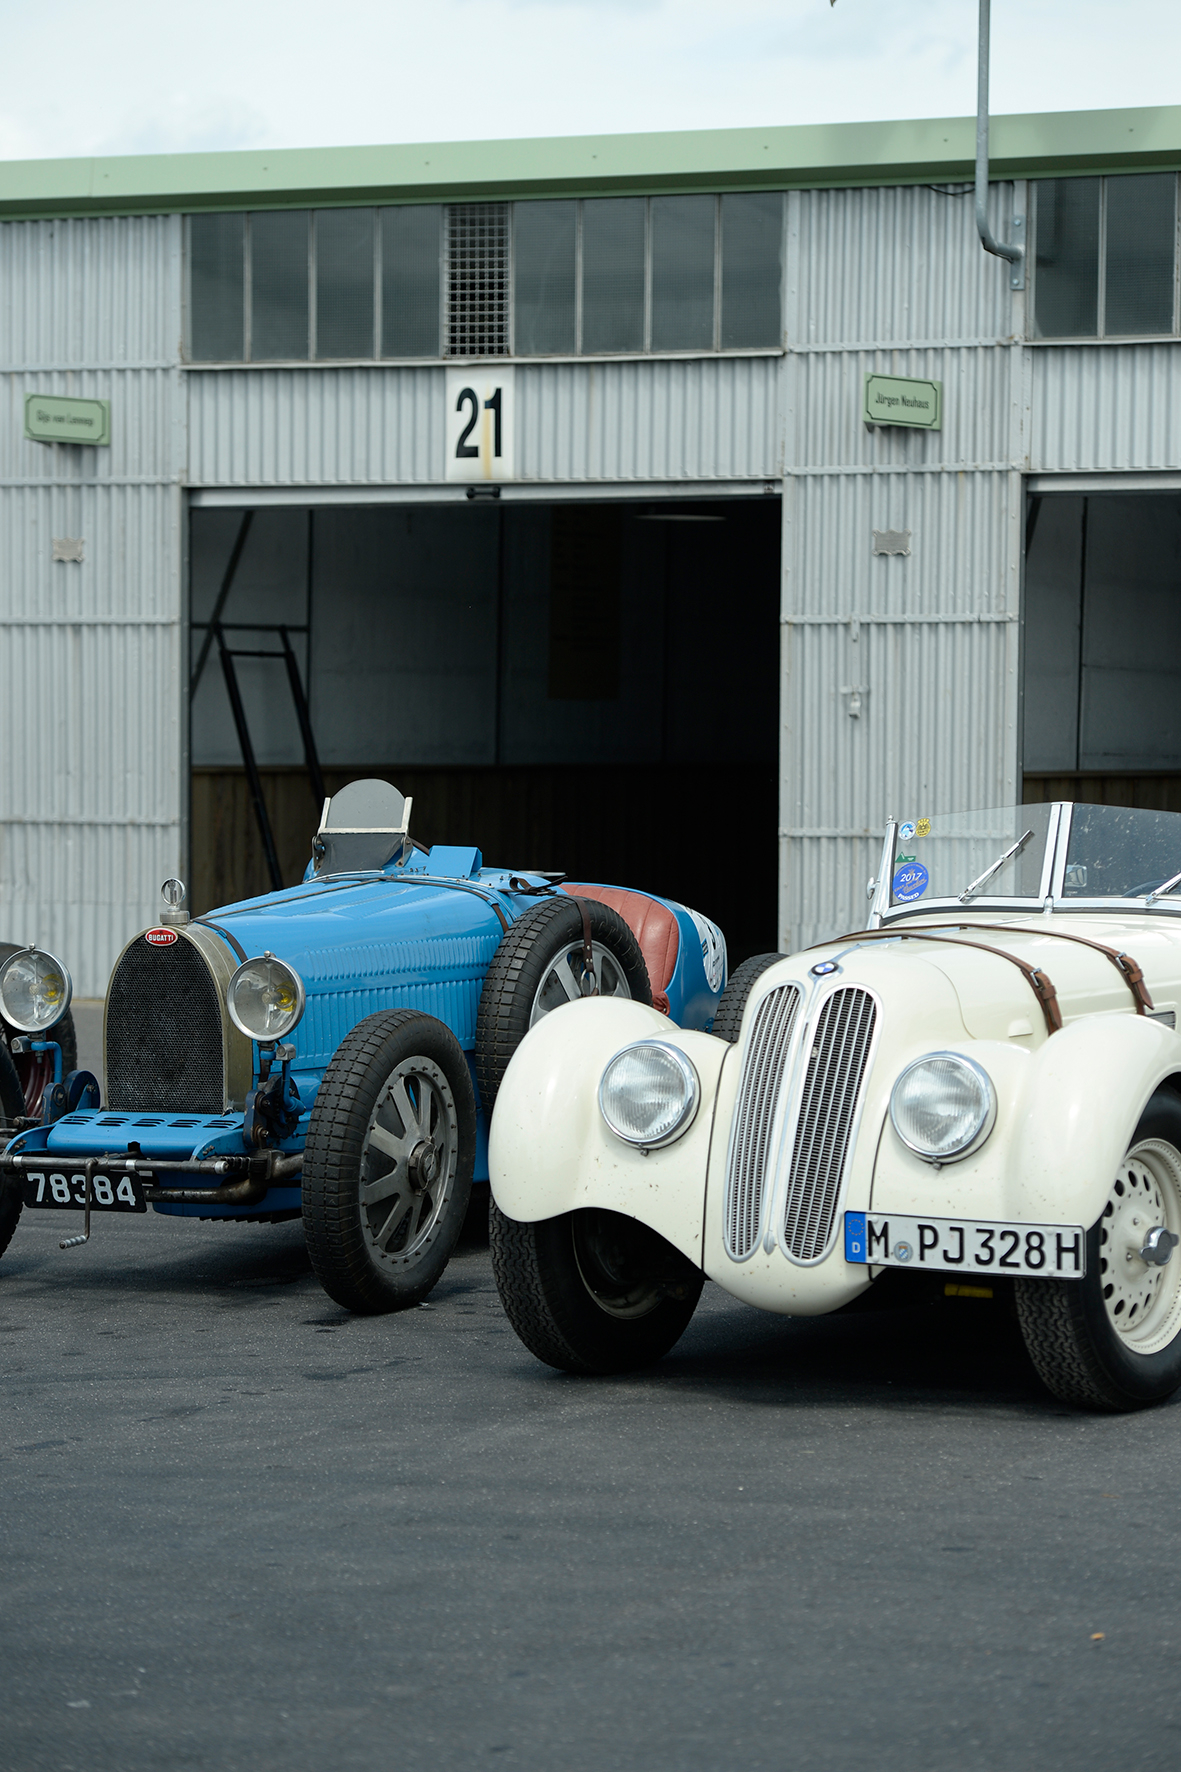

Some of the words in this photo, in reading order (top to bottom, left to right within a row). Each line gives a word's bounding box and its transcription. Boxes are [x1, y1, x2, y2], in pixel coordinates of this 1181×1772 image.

[875, 392, 899, 408] Jürgen
[901, 395, 929, 410] Neuhaus
[455, 386, 502, 459] 21
[900, 872, 923, 882] 2017
[148, 934, 174, 942] BUGATTI
[26, 1172, 136, 1206] 78384
[852, 1241, 861, 1254] D
[867, 1219, 889, 1259] M
